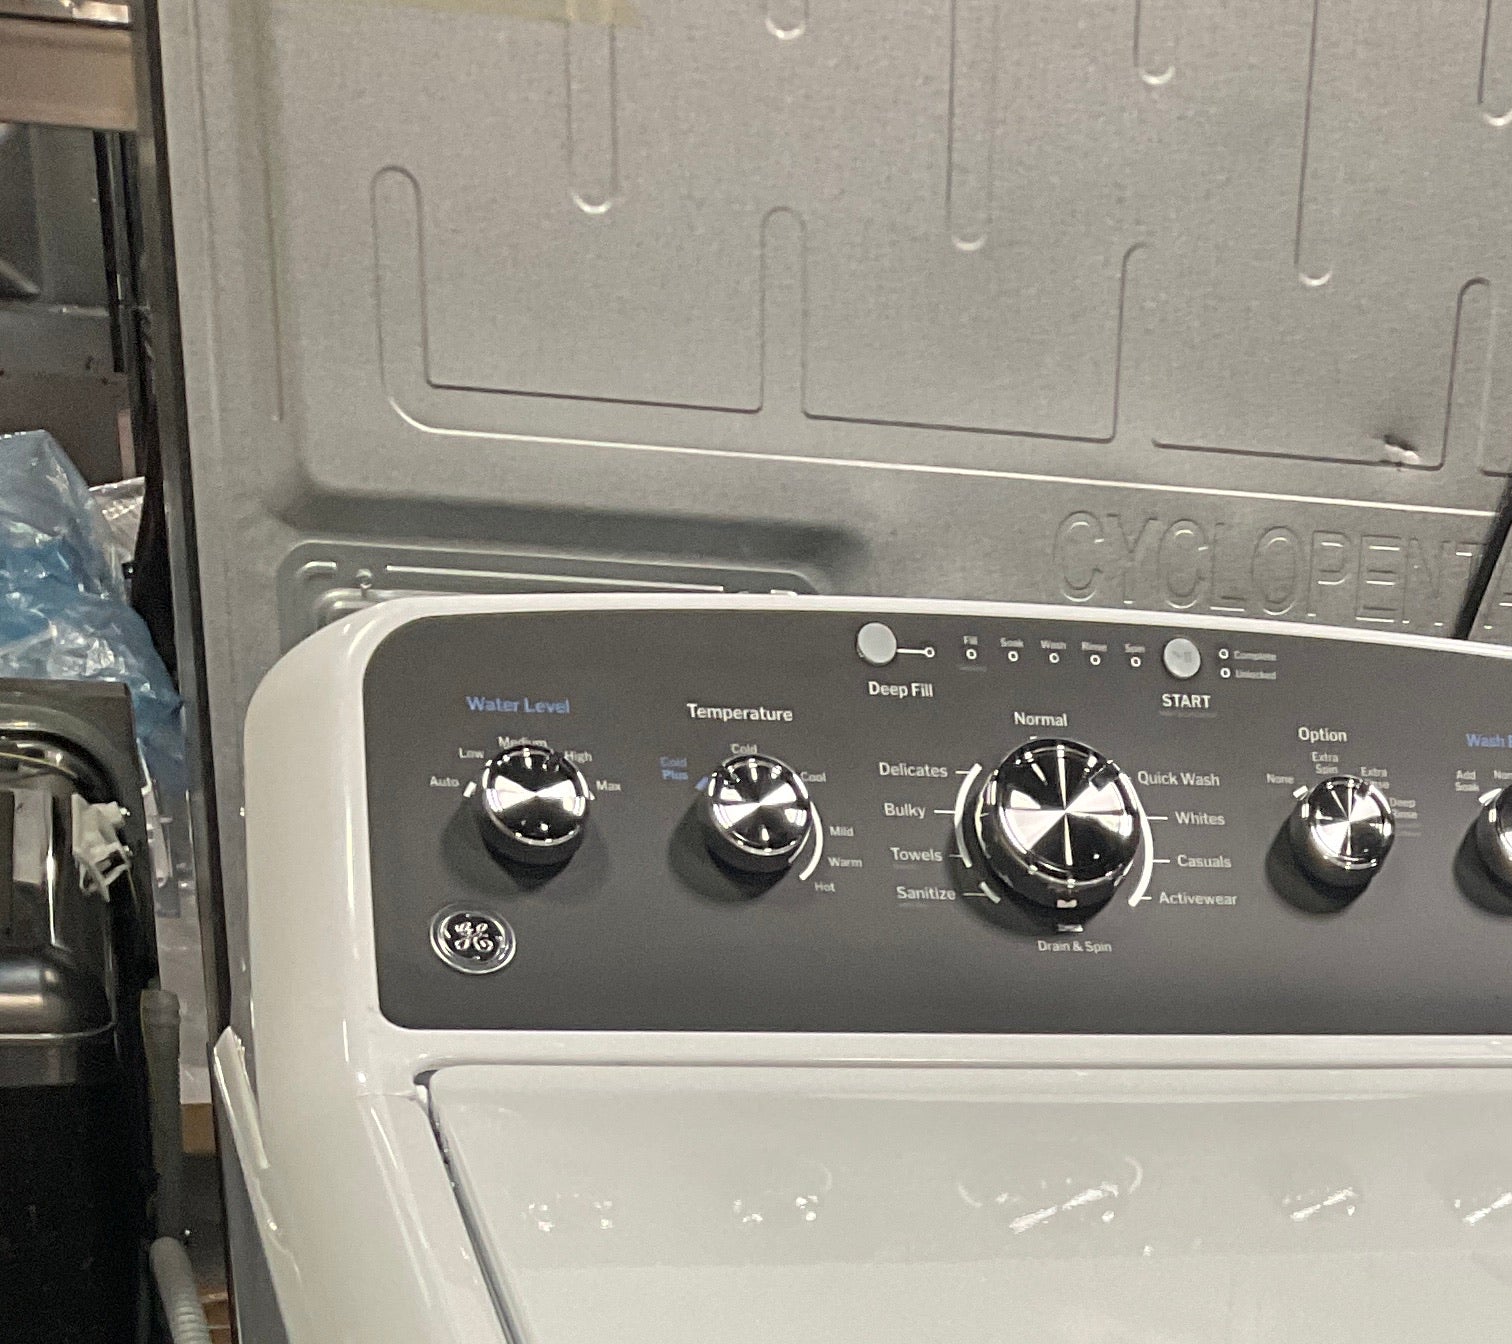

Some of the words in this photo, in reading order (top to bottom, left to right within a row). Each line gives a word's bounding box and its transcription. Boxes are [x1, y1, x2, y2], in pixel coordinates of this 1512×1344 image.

[868, 681, 908, 698] Deep
[911, 682, 934, 697] Fill
[466, 696, 520, 712] Water
[524, 697, 571, 714] Level
[1161, 693, 1211, 708] START
[687, 703, 793, 722] Temperature
[1014, 711, 1068, 727] Normal
[1298, 726, 1348, 744] Option
[1466, 733, 1505, 749] Wash
[458, 747, 484, 759] Low
[731, 743, 758, 755] Cold
[564, 751, 592, 764] High
[1311, 751, 1339, 763] Extra
[662, 770, 688, 781] Plus
[879, 762, 948, 778] Delicates
[1315, 764, 1339, 775] Spin
[1360, 767, 1388, 778] Extra
[1456, 769, 1477, 781] Add
[430, 776, 460, 788] Auto
[801, 771, 826, 783] Cool
[1137, 770, 1178, 786] Quick
[1180, 771, 1220, 787] Wash
[1266, 772, 1295, 785] None
[596, 780, 621, 792] Max
[884, 803, 926, 819] Bulky
[1175, 811, 1226, 825] Whites
[830, 826, 854, 837] Mild
[890, 847, 943, 862] Towels
[1177, 854, 1232, 868] Casuals
[828, 857, 863, 868] Warm
[814, 882, 835, 893] Hot
[896, 886, 956, 901] Sanitize
[1159, 891, 1237, 905] Activewear
[1038, 940, 1070, 952] Drain
[1072, 941, 1083, 951] &
[1086, 942, 1112, 954] Spin
